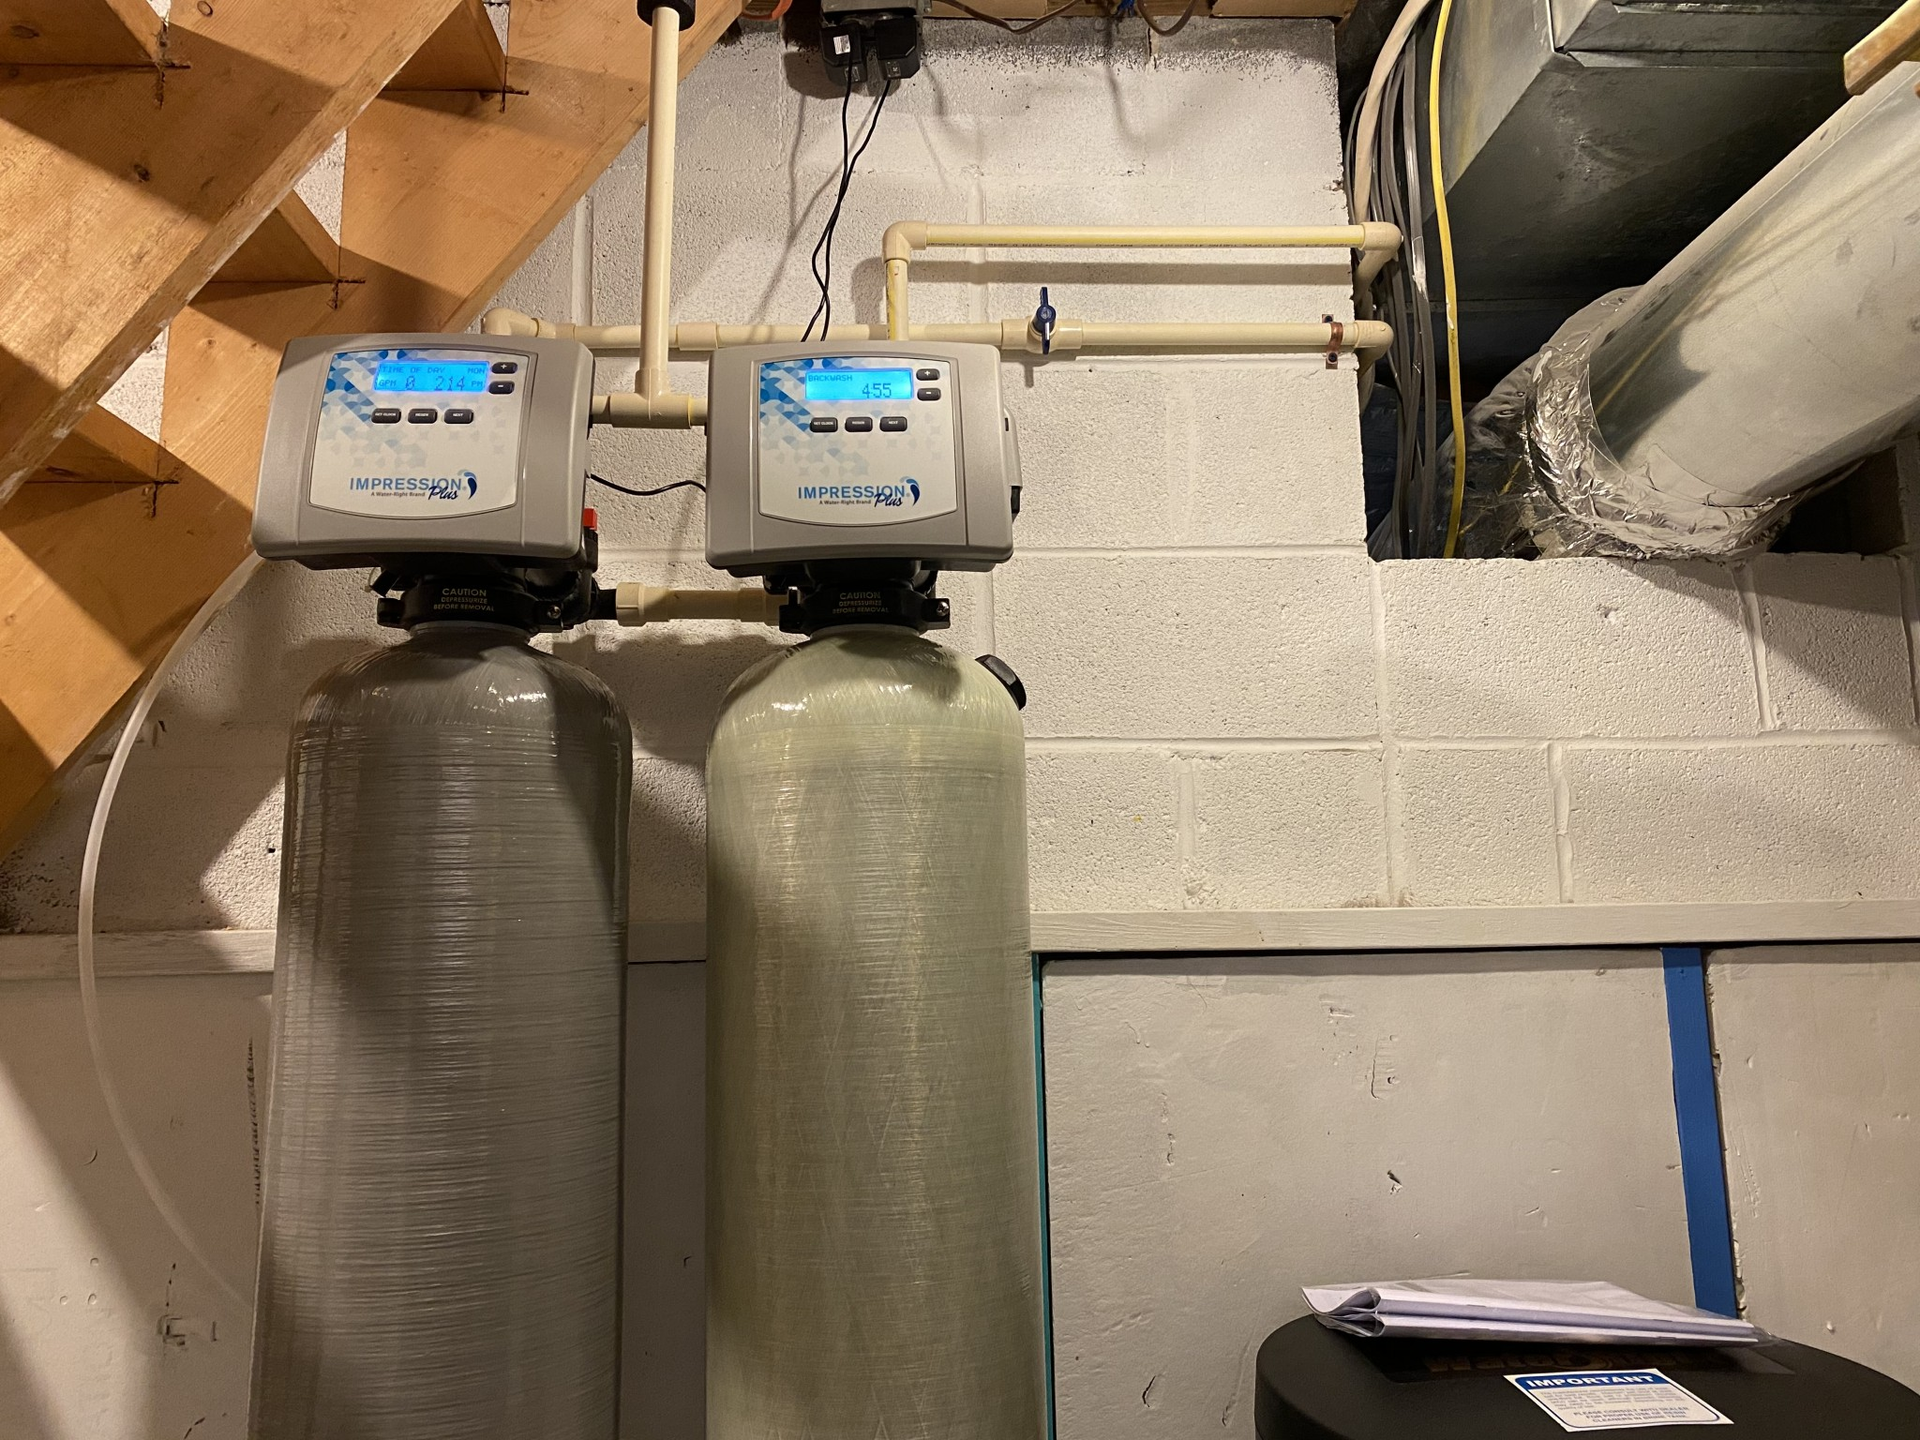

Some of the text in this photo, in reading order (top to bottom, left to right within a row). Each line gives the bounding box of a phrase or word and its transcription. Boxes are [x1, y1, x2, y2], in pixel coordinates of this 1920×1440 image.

[350, 478, 462, 490] IMPRESSION
[428, 486, 458, 500] Plus
[798, 486, 905, 499] IMPRESSION
[874, 492, 902, 508] Plus
[442, 588, 487, 597] CAUTION
[840, 592, 881, 600] CAUTION
[1526, 1376, 1654, 1388] IMPORTANT
